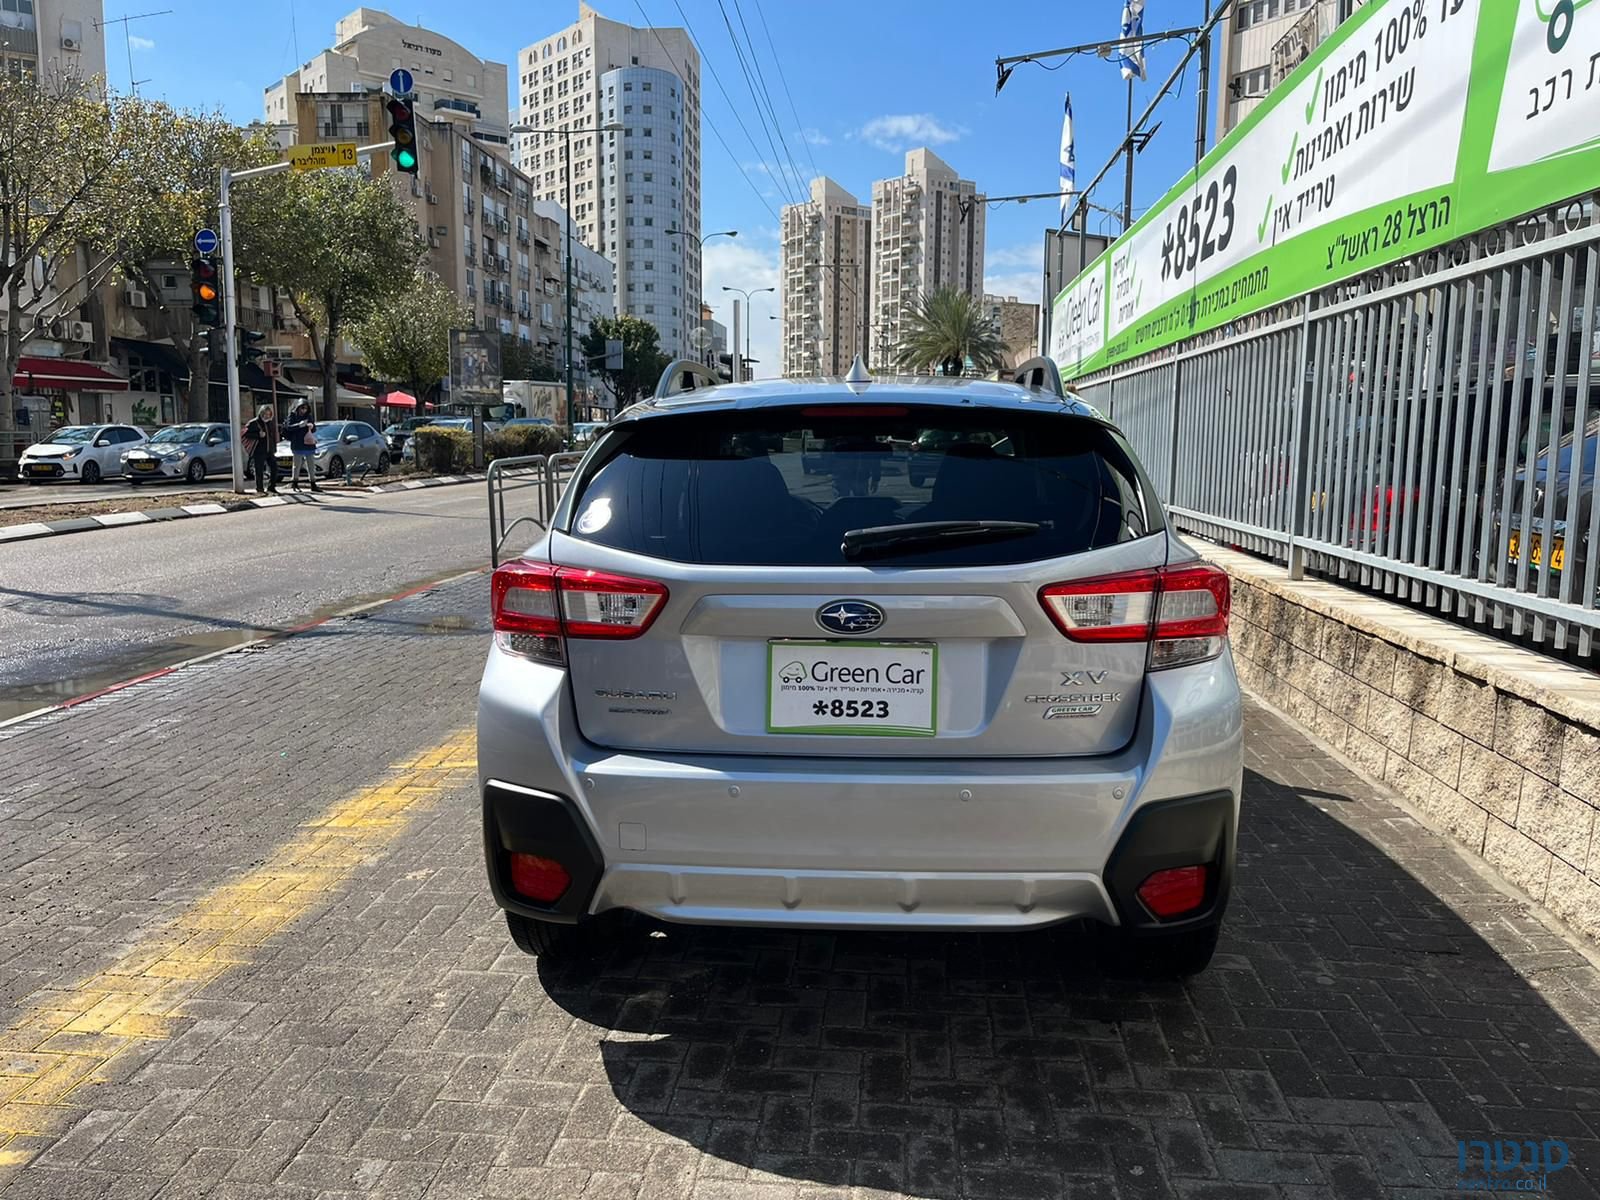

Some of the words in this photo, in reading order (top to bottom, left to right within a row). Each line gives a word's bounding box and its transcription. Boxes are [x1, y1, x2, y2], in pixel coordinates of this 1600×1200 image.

[1375, 0, 1427, 73] 100%
[1323, 49, 1367, 123] מימון
[1355, 65, 1416, 141] שירות
[1526, 68, 1573, 121] רכב
[341, 148, 353, 160] 13
[1293, 111, 1353, 182] ואמינות
[1297, 174, 1336, 224] טרייד
[1407, 195, 1451, 240] הרצל
[1272, 199, 1293, 247] אין
[1382, 209, 1403, 249] 28
[1087, 277, 1103, 326] Car
[1231, 265, 1269, 304] מתמחים
[594, 688, 678, 700] SUBARU
[811, 661, 879, 684] Green
[885, 662, 925, 685] Car
[1060, 669, 1109, 686] XV
[1024, 692, 1121, 704] CROSSTREK
